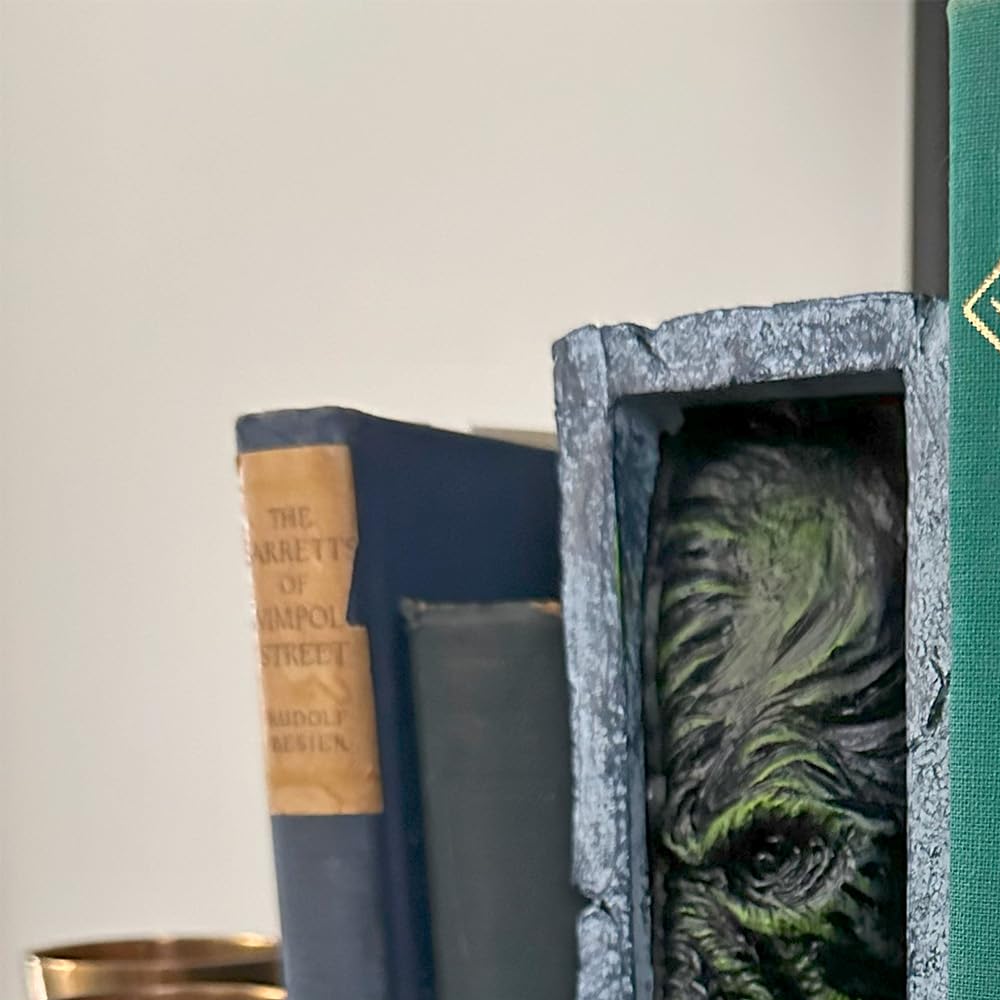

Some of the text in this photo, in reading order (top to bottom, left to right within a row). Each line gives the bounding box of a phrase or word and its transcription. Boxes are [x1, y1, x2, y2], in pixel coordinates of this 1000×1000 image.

[266, 505, 313, 529] THE
[250, 536, 356, 562] ARRETTS
[280, 574, 308, 594] OF
[257, 604, 345, 630] IMPOL
[261, 641, 351, 667] STREET
